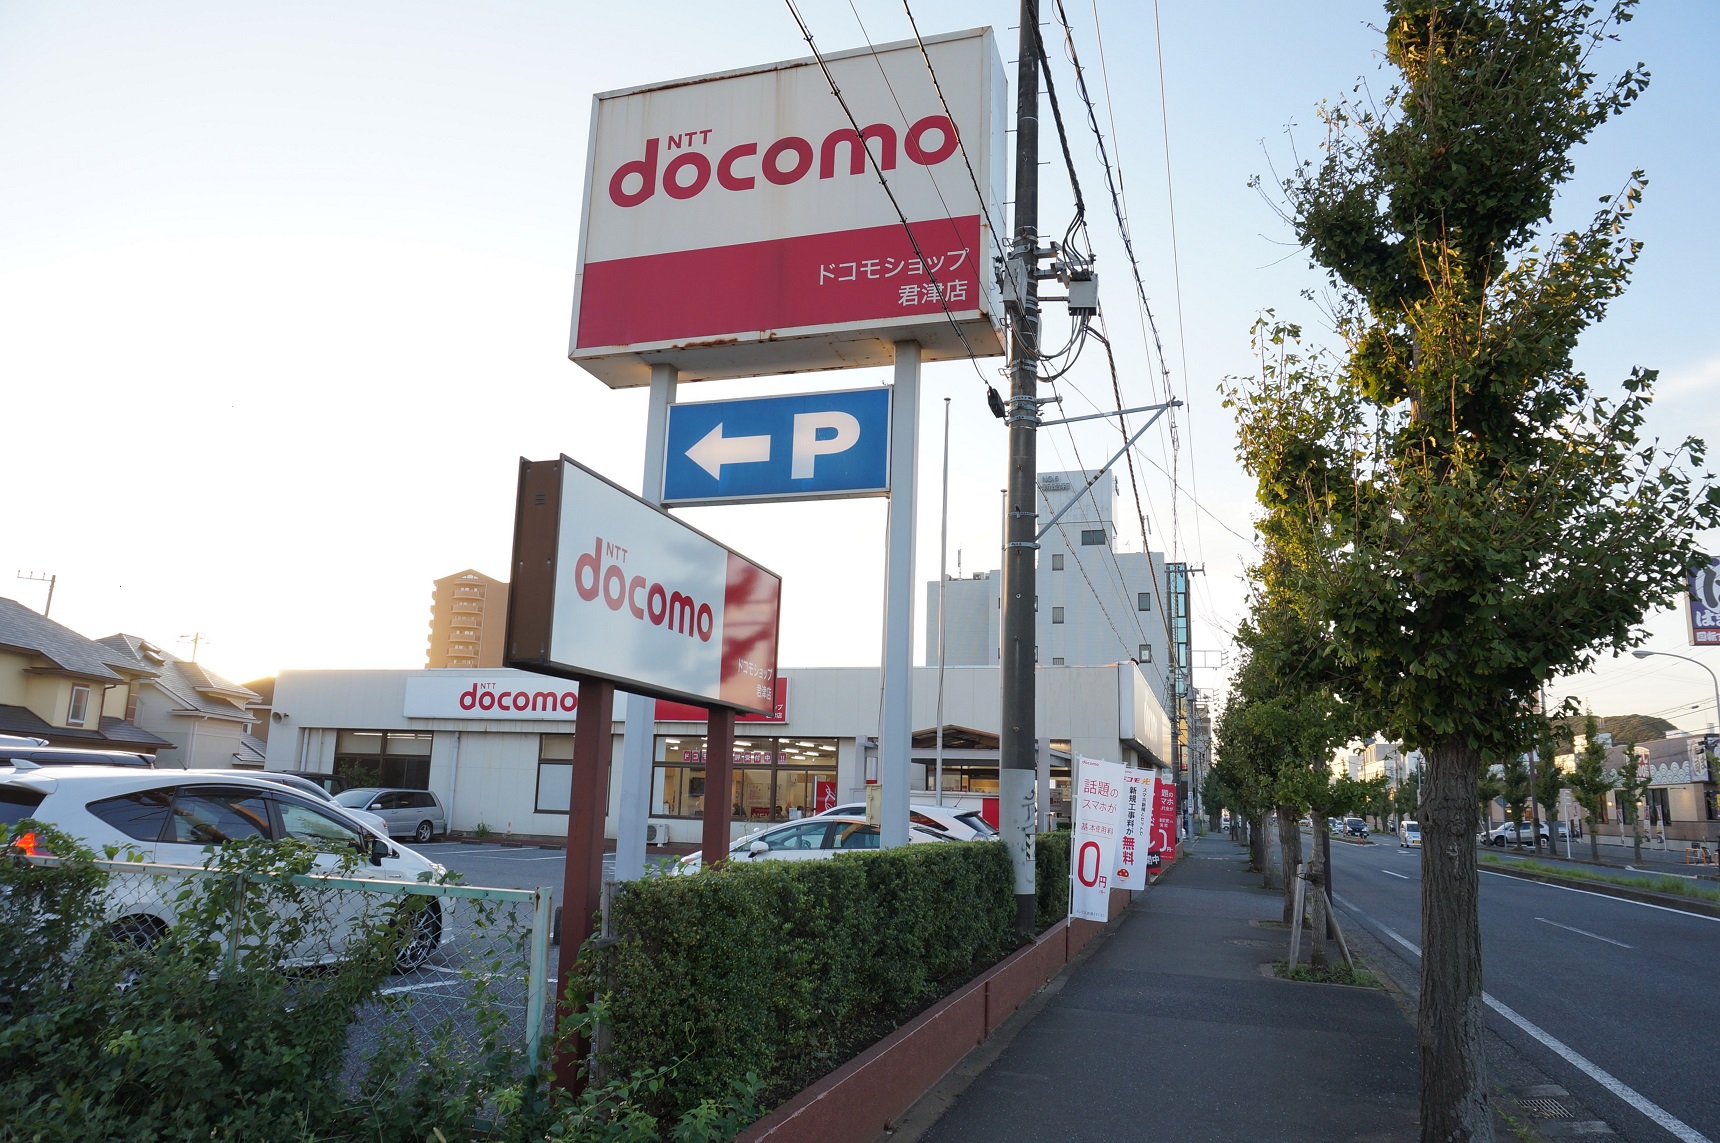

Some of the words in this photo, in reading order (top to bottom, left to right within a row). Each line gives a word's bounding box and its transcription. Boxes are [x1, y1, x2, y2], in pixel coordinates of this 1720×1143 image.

[668, 129, 712, 151] NTT
[609, 115, 960, 208] docomo
[819, 247, 970, 285] ドコモショップ
[898, 279, 968, 307] 君津店
[791, 411, 861, 480] P
[606, 541, 628, 563] NTT
[575, 536, 713, 643] docomo
[737, 658, 773, 681] ドコモショップ
[459, 682, 578, 712] docomo
[480, 682, 497, 690] NTT
[1083, 778, 1119, 798] 話題の
[1082, 799, 1117, 814] スマホが
[1081, 822, 1114, 836] 基本使用料
